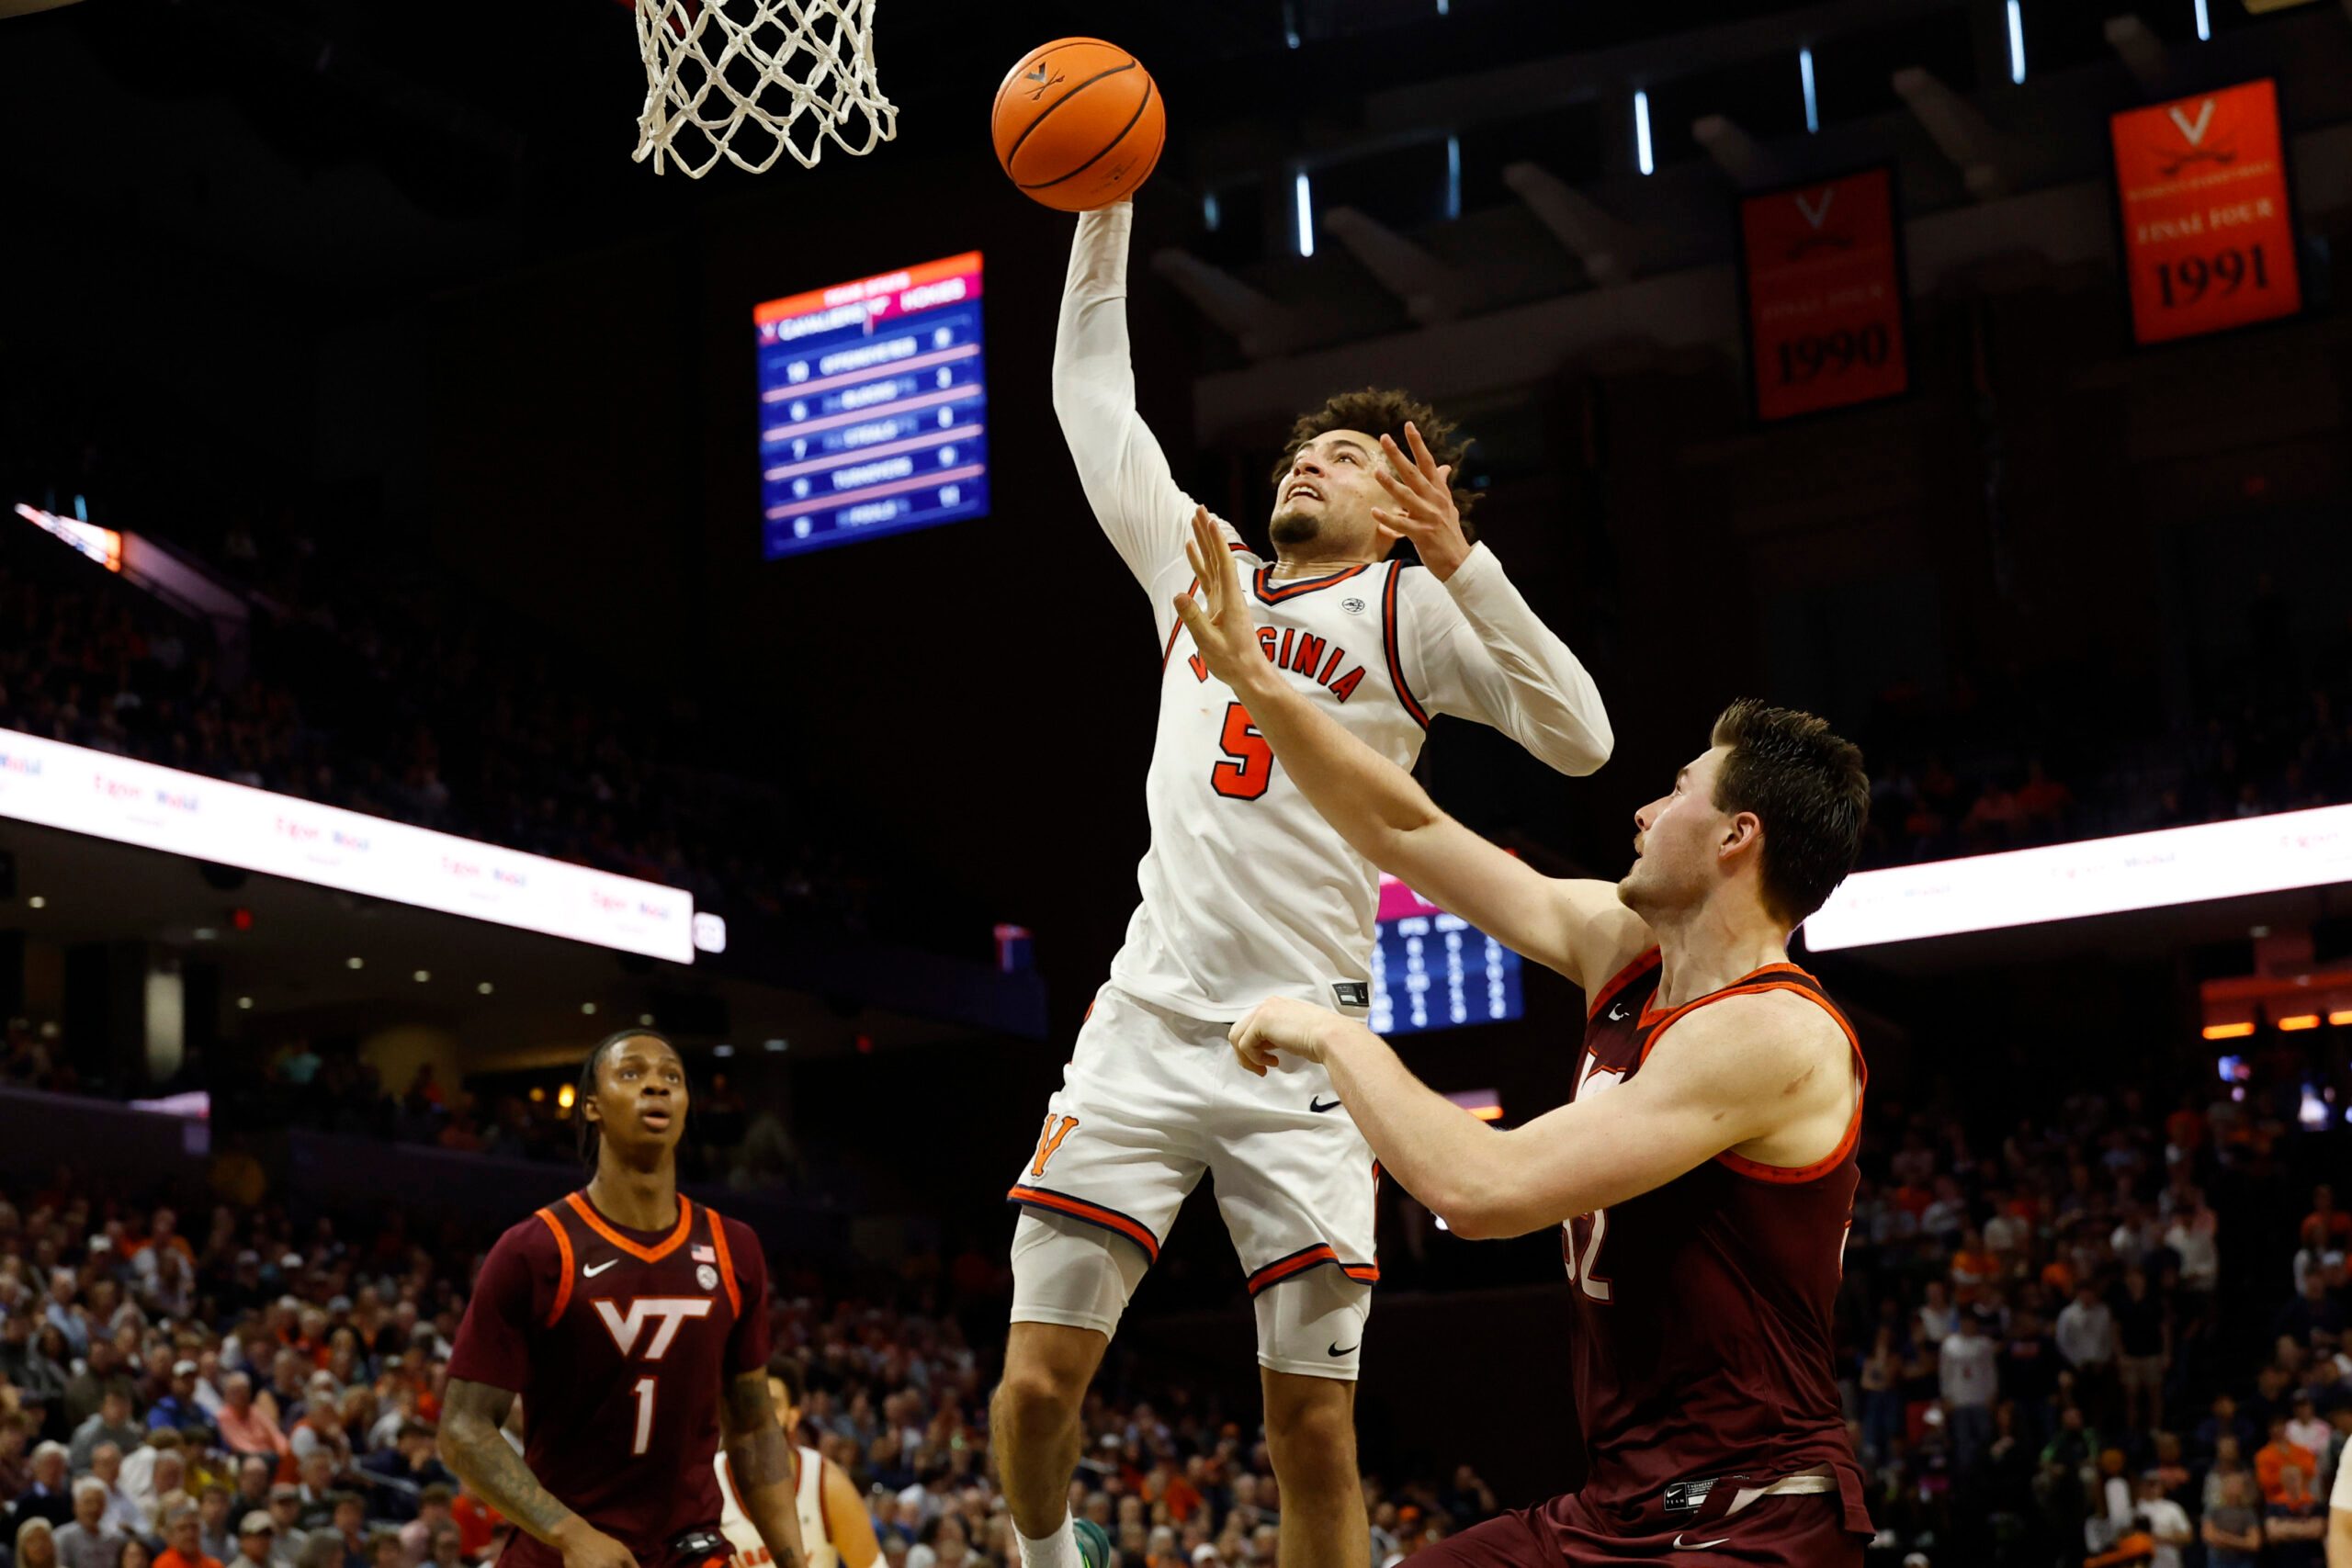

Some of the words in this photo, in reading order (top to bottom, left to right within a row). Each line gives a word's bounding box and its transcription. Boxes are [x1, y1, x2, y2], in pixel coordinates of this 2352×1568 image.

[2156, 244, 2269, 309] 1991
[1776, 322, 1889, 385] 1990
[1188, 626, 1366, 704] VGINIA
[1210, 701, 1275, 801] 5
[589, 1294, 717, 1361] VT
[629, 1375, 659, 1458] 1
